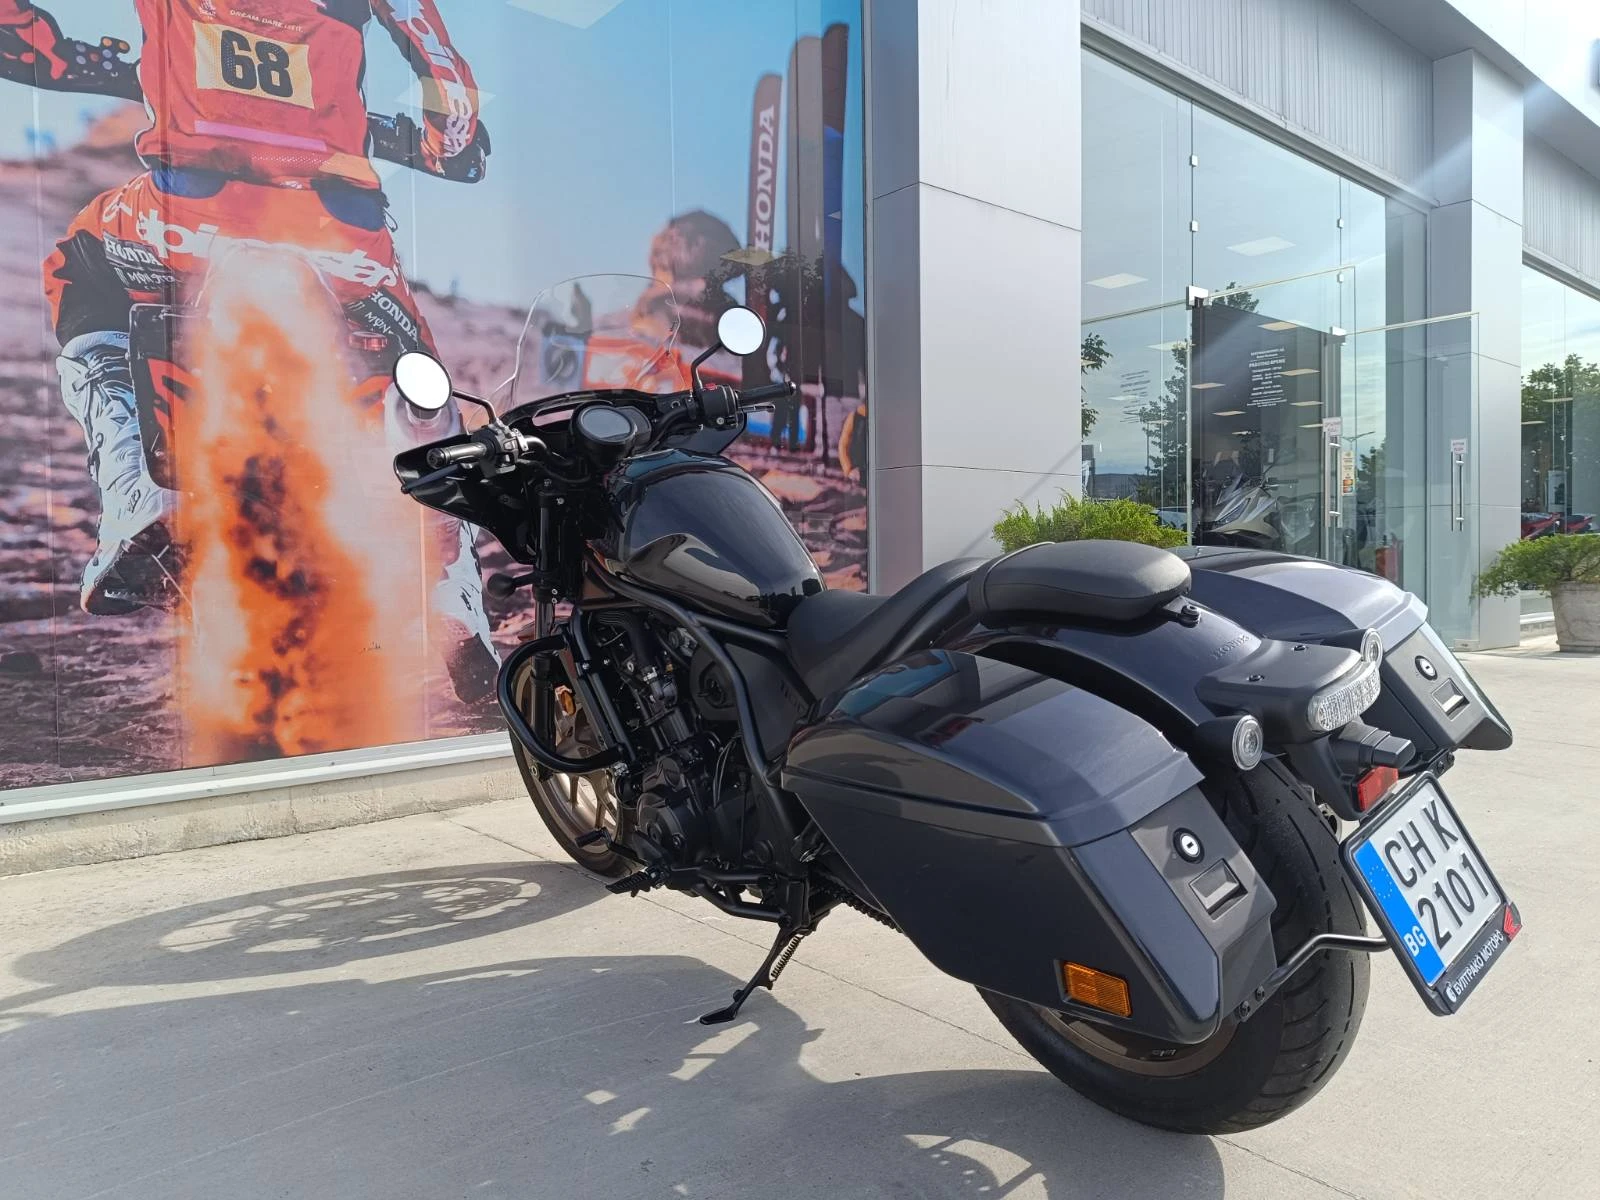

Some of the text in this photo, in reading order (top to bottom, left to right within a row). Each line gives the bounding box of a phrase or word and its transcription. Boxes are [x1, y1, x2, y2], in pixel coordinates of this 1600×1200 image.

[220, 29, 293, 98] 68
[753, 104, 775, 252] HONDA
[368, 288, 418, 341] HONDA
[1384, 800, 1458, 888] CH K
[1417, 852, 1489, 951] 2101
[1403, 925, 1427, 957] BG
